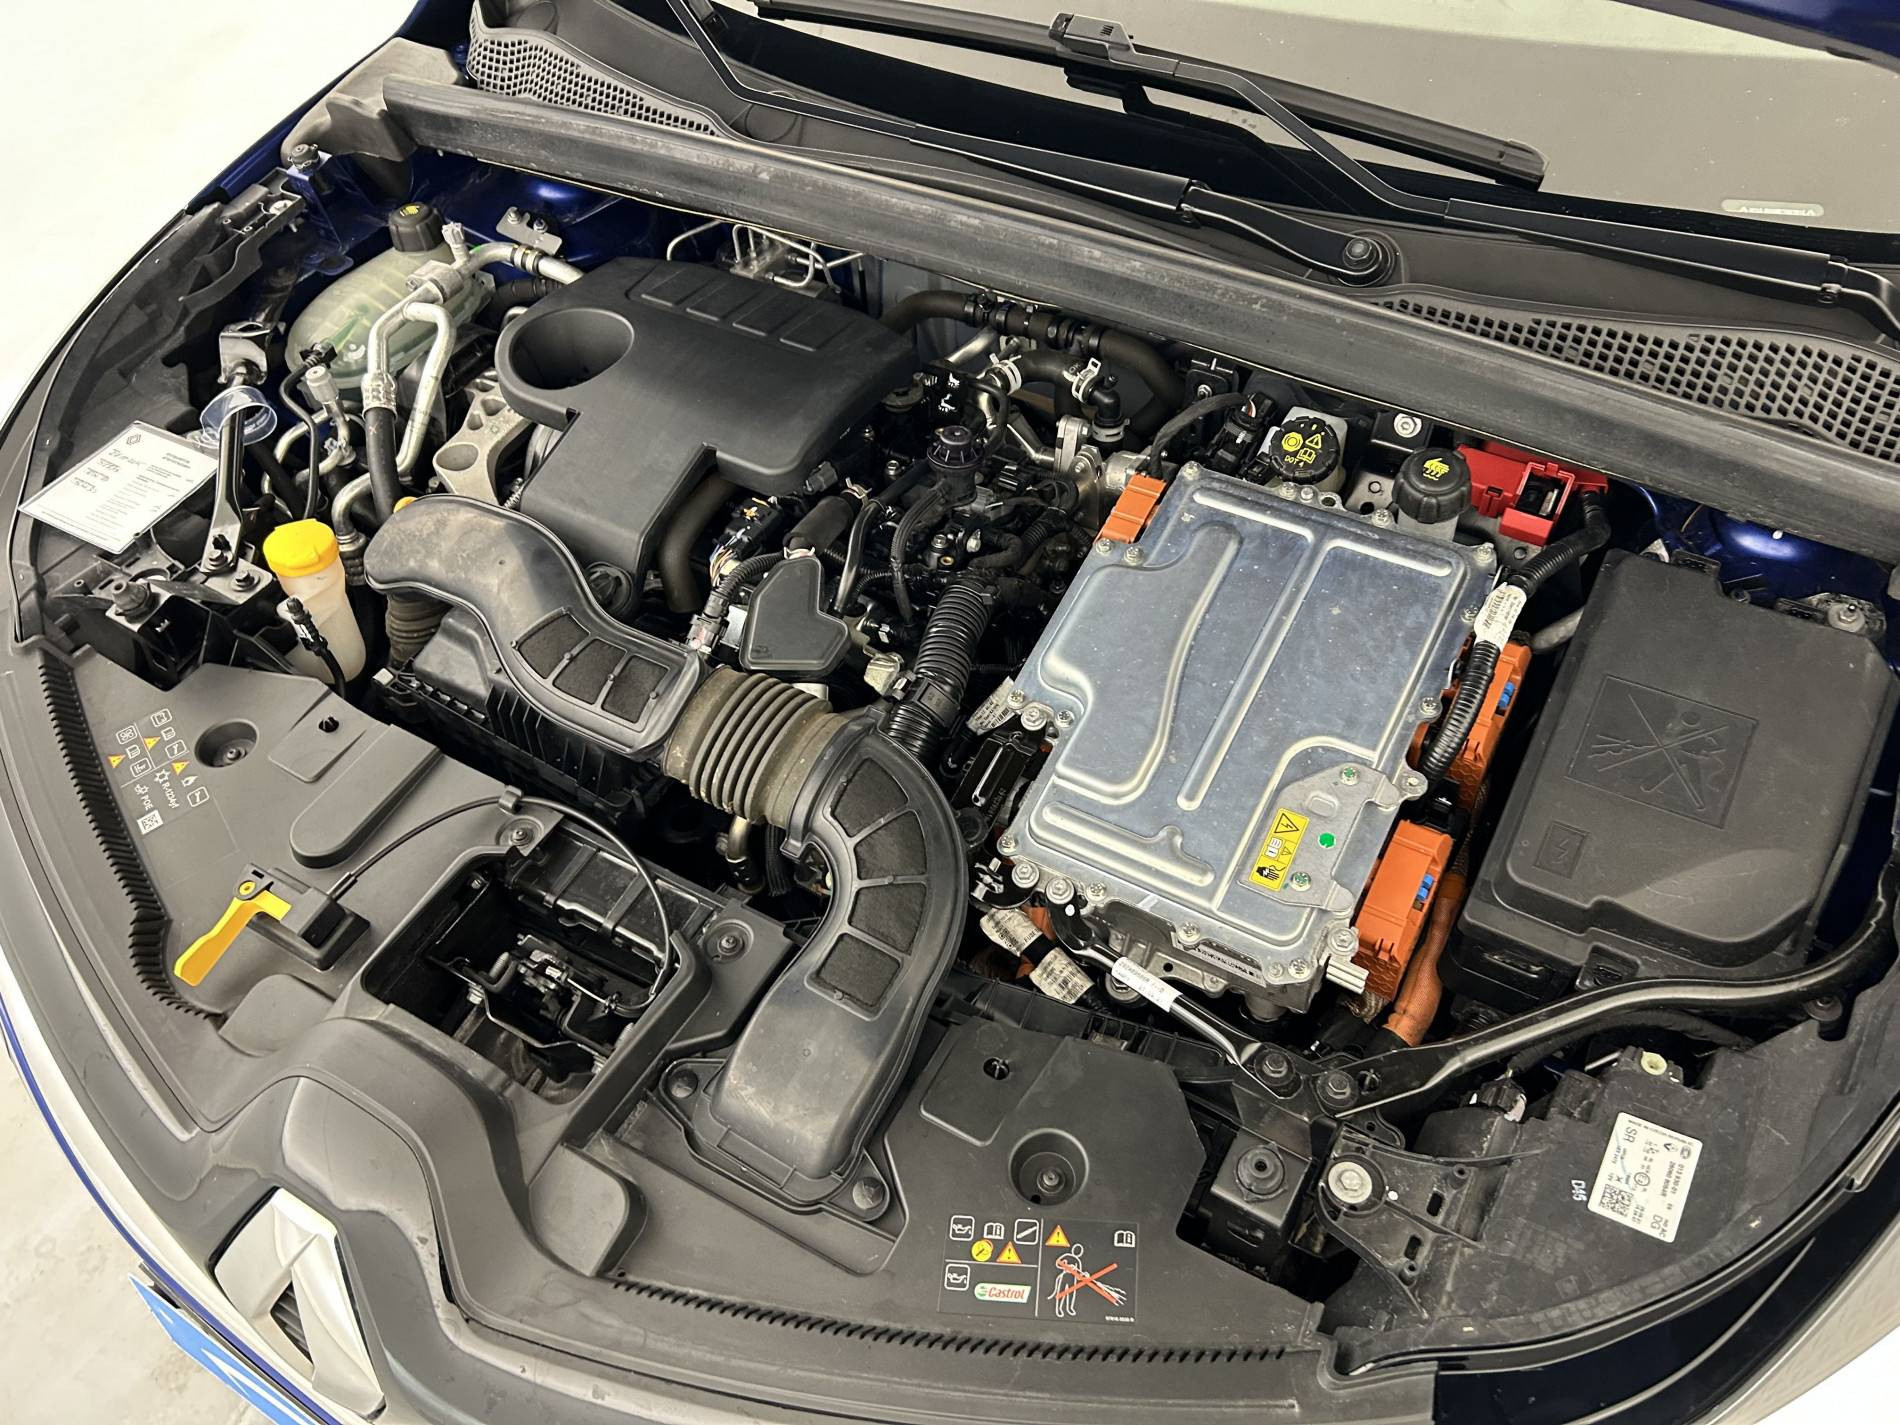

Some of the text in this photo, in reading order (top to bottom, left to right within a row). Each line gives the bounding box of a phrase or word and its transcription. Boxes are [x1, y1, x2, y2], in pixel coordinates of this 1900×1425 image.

[1284, 455, 1299, 464] DOT
[140, 794, 154, 811] POE
[987, 1286, 1026, 1300] Castrol
